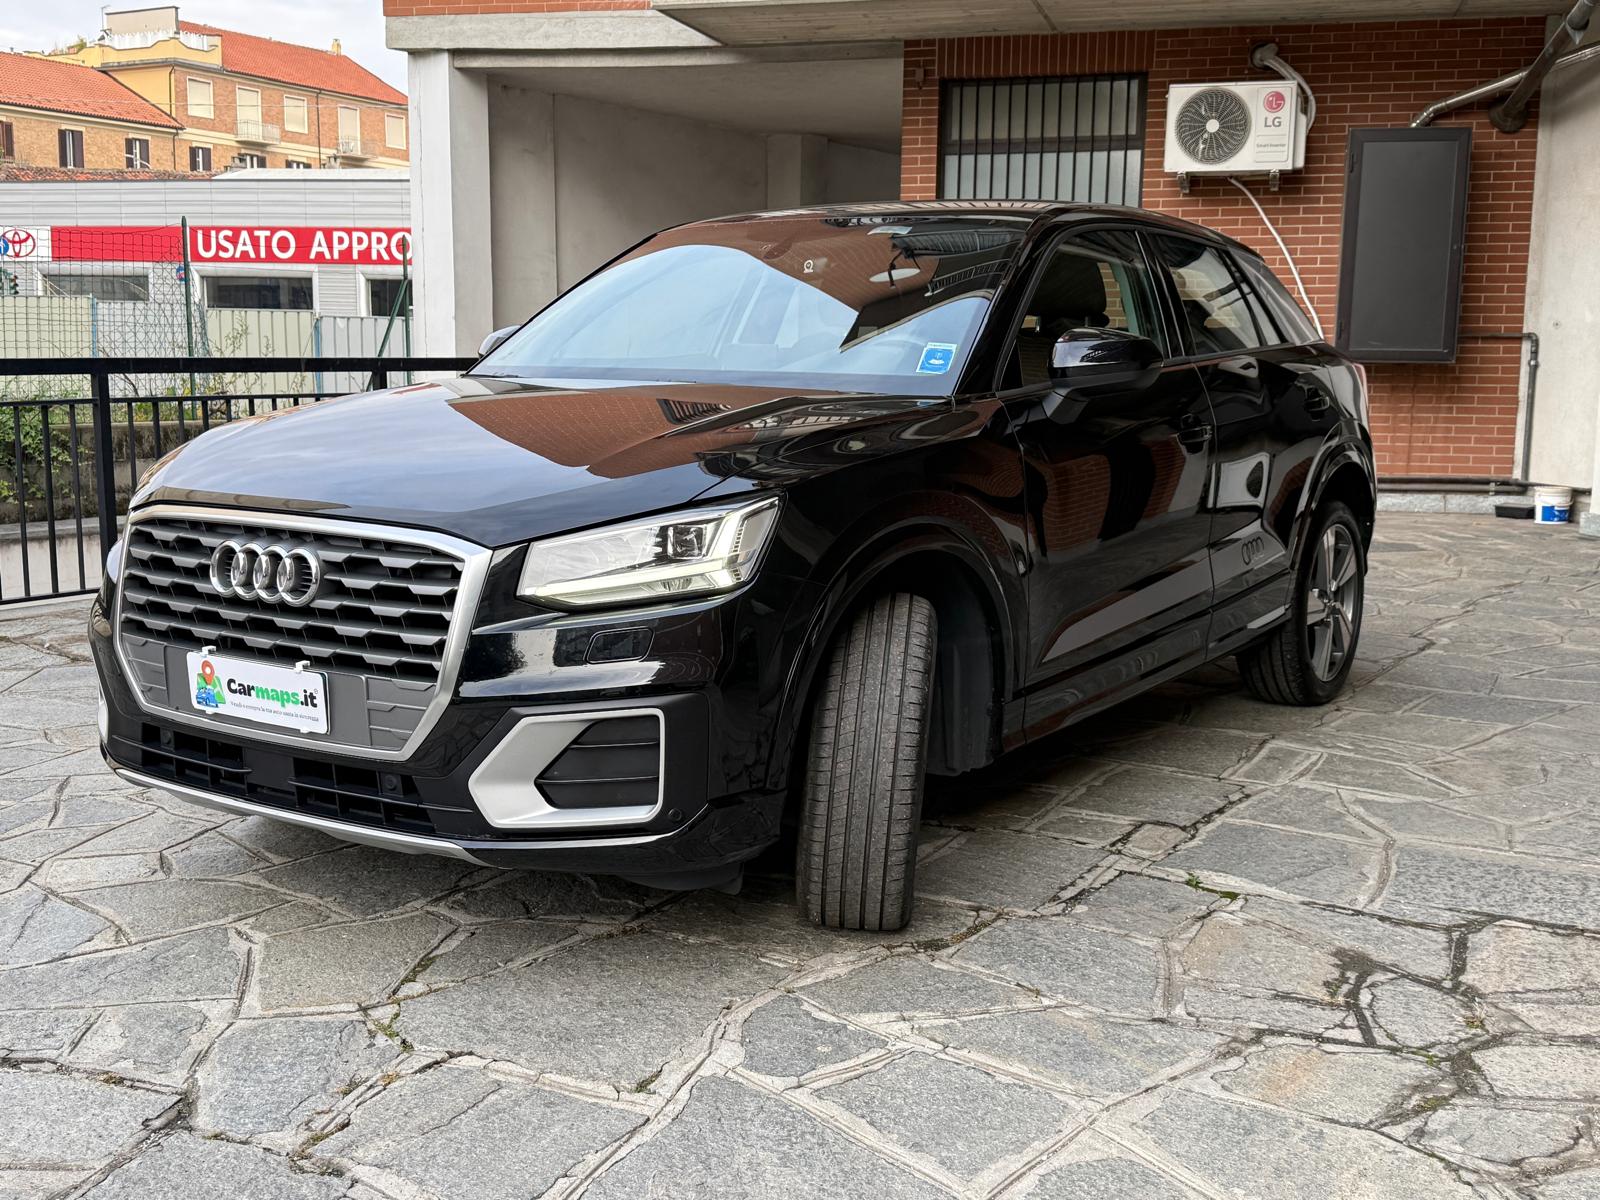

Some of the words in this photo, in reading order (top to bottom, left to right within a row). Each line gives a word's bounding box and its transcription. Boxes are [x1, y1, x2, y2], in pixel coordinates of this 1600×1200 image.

[1264, 116, 1282, 128] LG
[197, 229, 296, 259] USATO
[309, 230, 412, 261] APPRO
